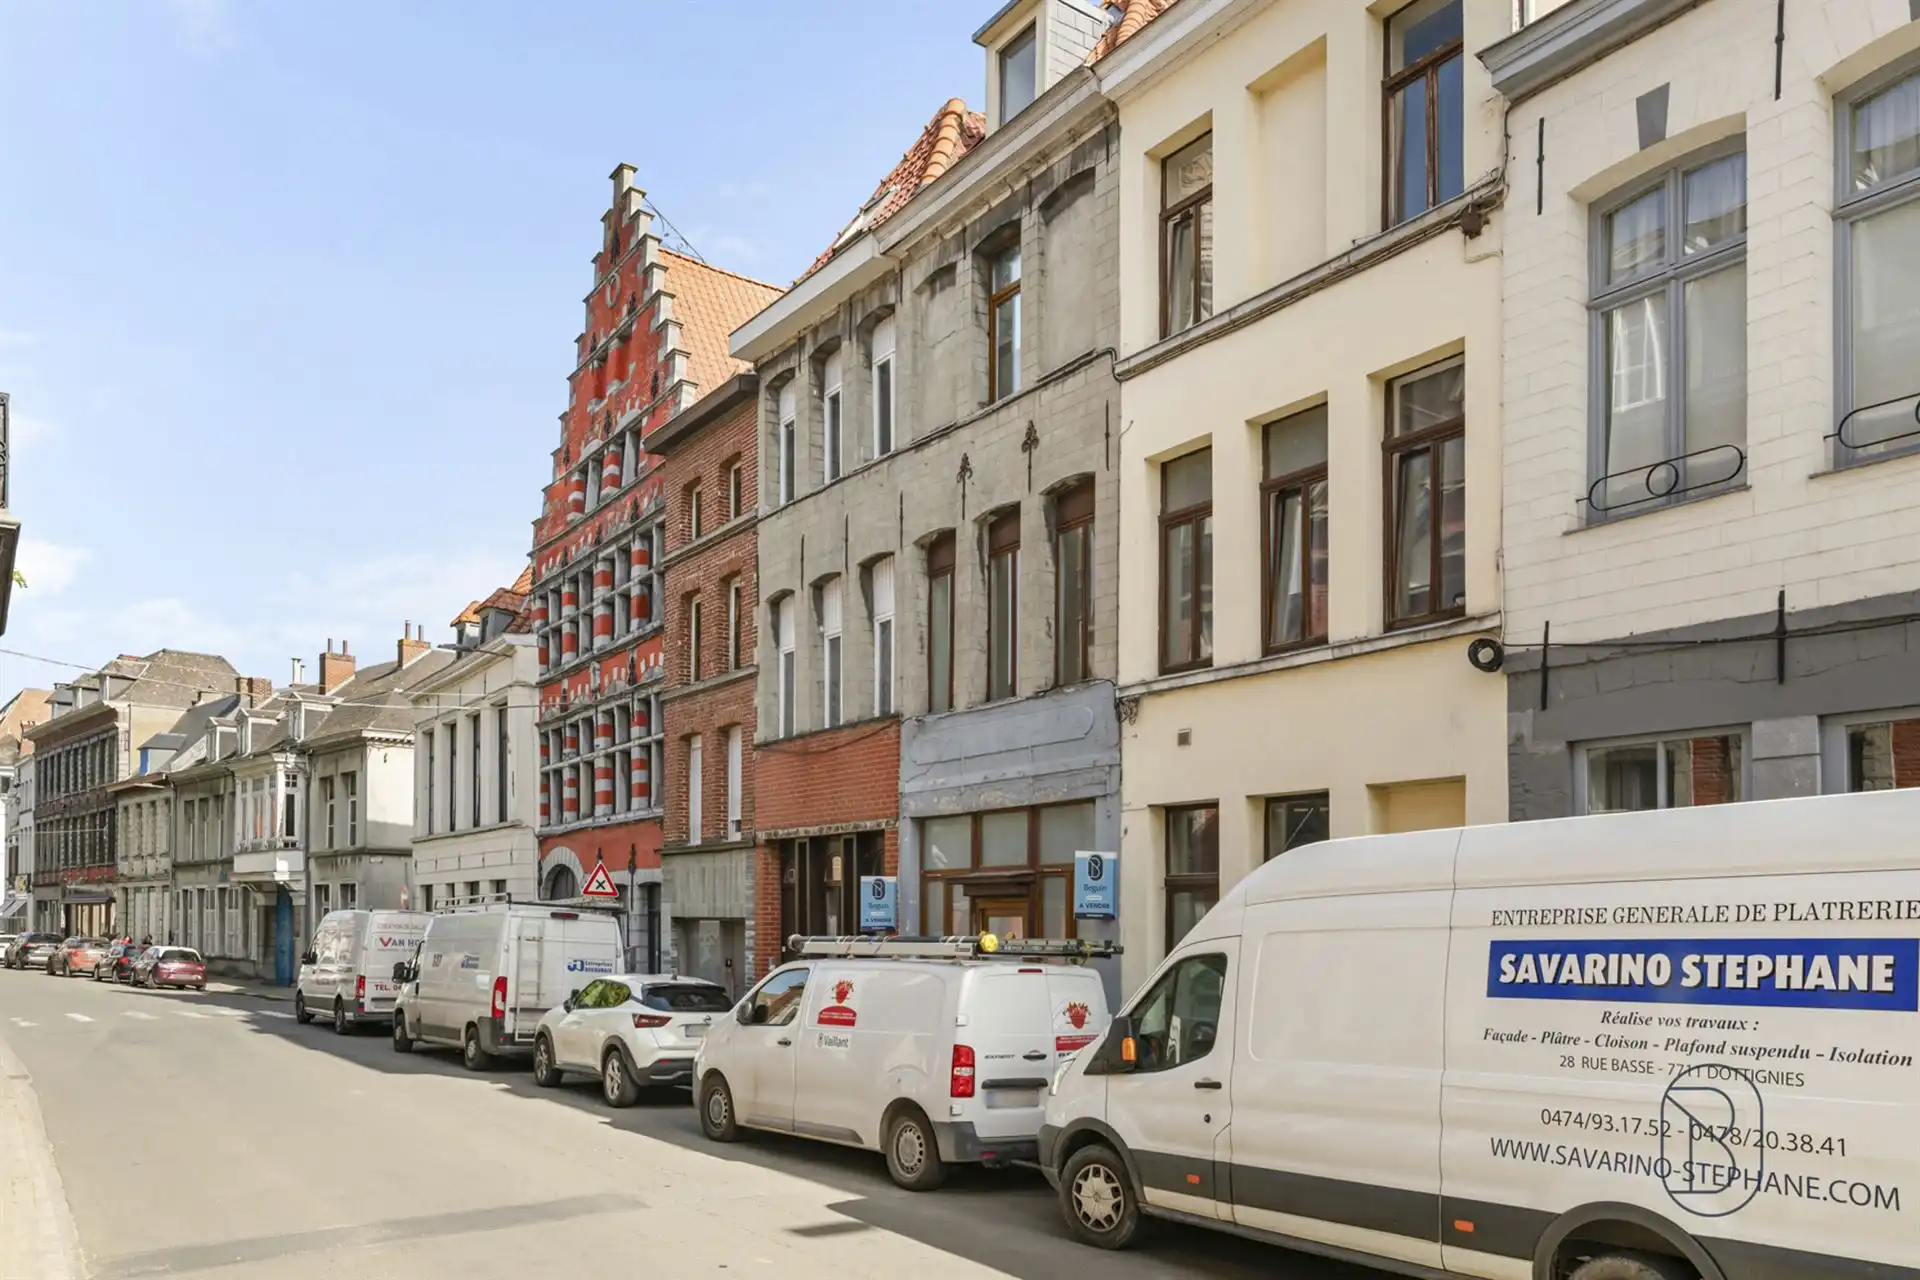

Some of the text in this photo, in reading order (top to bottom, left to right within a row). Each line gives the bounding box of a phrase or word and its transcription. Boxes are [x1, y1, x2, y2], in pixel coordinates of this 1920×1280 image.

[1491, 900, 1920, 926] ENTREPRISE GENERALE DE PLATRERIE
[379, 937, 405, 947] VAN
[1499, 953, 1895, 993] SAVARINO STEPHANE
[1600, 1010, 1653, 1026] Réalise
[1657, 1015, 1682, 1028] vos
[1686, 1015, 1748, 1031] travaux
[823, 1035, 849, 1048] Vaillant
[1483, 1027, 1528, 1044] Façade
[1540, 1030, 1581, 1046] Plâtre
[1594, 1033, 1648, 1050] Cloison
[1664, 1037, 1727, 1056] Plafond
[1730, 1043, 1811, 1060] suspendu
[1828, 1046, 1913, 1067] Isolation
[1559, 1055, 1576, 1068] 28
[1581, 1056, 1608, 1071] RUE
[1611, 1058, 1655, 1075] BASSE
[1667, 1063, 1701, 1079] 7711
[1707, 1064, 1805, 1087] DOTTIGNIES
[1541, 1108, 1672, 1138] 0474/93.17.52
[1690, 1124, 1846, 1157] 0478/20.38.41
[1490, 1137, 1901, 1211] WWW.SAVARINO-STEPHANE.COM
